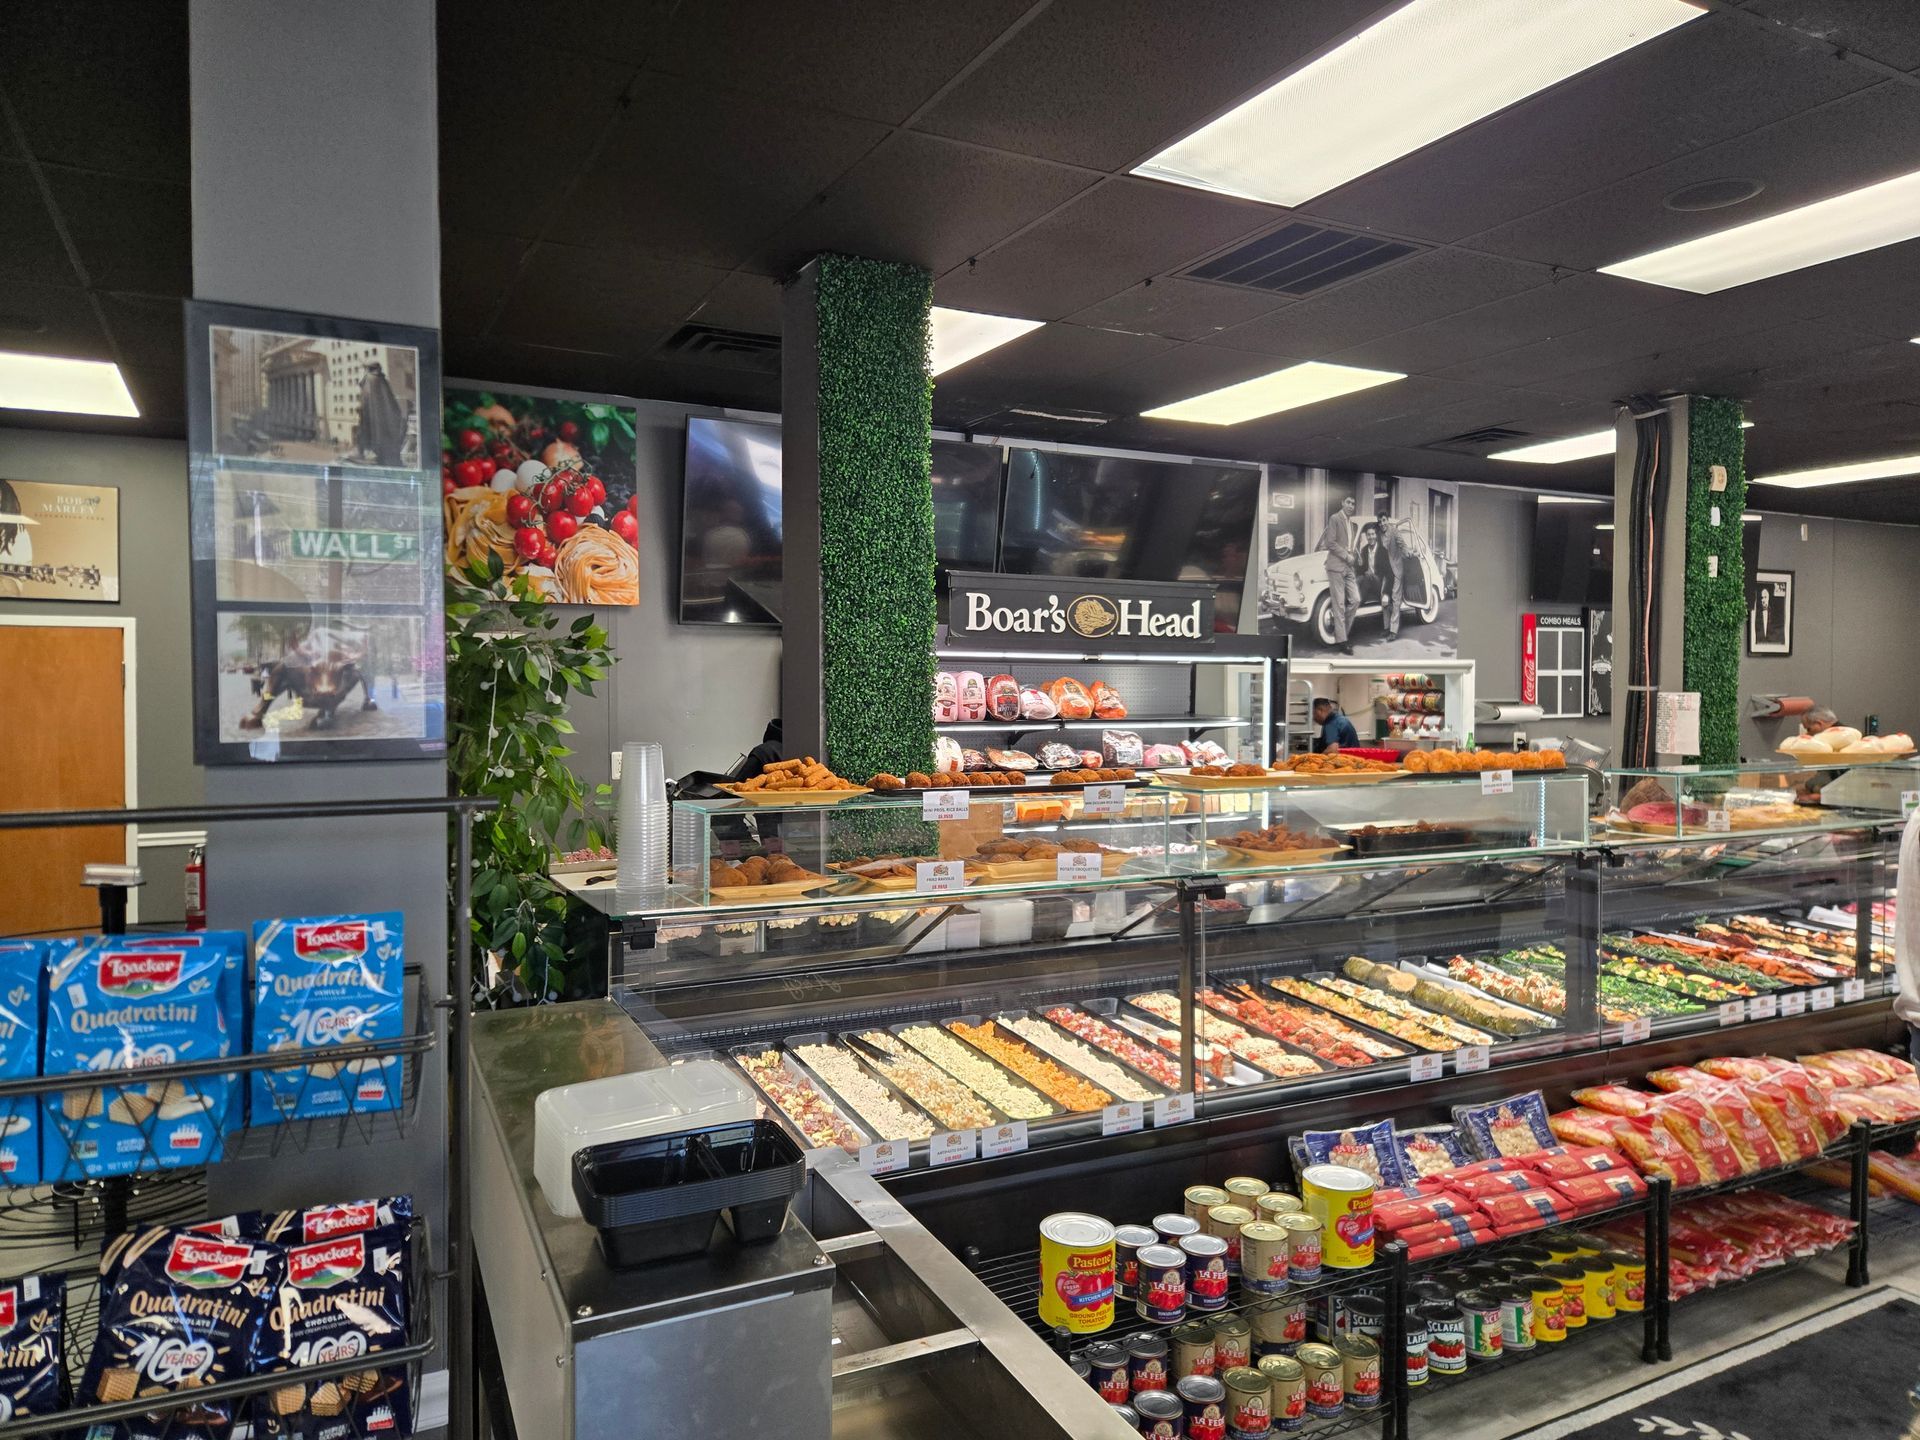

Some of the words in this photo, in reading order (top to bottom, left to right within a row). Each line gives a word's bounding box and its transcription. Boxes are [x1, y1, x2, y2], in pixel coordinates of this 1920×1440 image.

[42, 503, 97, 514] MARLEY
[298, 531, 391, 559] WALL
[394, 535, 416, 549] ST
[965, 592, 1066, 633] Boar's
[1117, 600, 1202, 639] Head
[1540, 616, 1561, 625] COMBO
[1562, 616, 1582, 625] MEALS
[298, 930, 360, 947] Loacker
[107, 958, 175, 978] Loacker
[274, 967, 386, 997] Quadratii
[71, 1003, 198, 1034] Quadratini
[178, 1245, 242, 1264] Loacker
[294, 1245, 358, 1269] Loacker
[1073, 1254, 1112, 1268] Pastene
[1199, 1270, 1211, 1278] LA
[1154, 1282, 1166, 1291] LA
[1078, 1292, 1101, 1303] KITCHEN
[130, 1290, 250, 1328] Quadratini
[1069, 1310, 1096, 1319] GROUND
[304, 1313, 351, 1328] CHOCOLAT
[1427, 1320, 1464, 1333] SCLAFAN
[129, 1337, 215, 1383] 100
[164, 1351, 204, 1367] YEARS
[318, 1343, 357, 1362] YEARS
